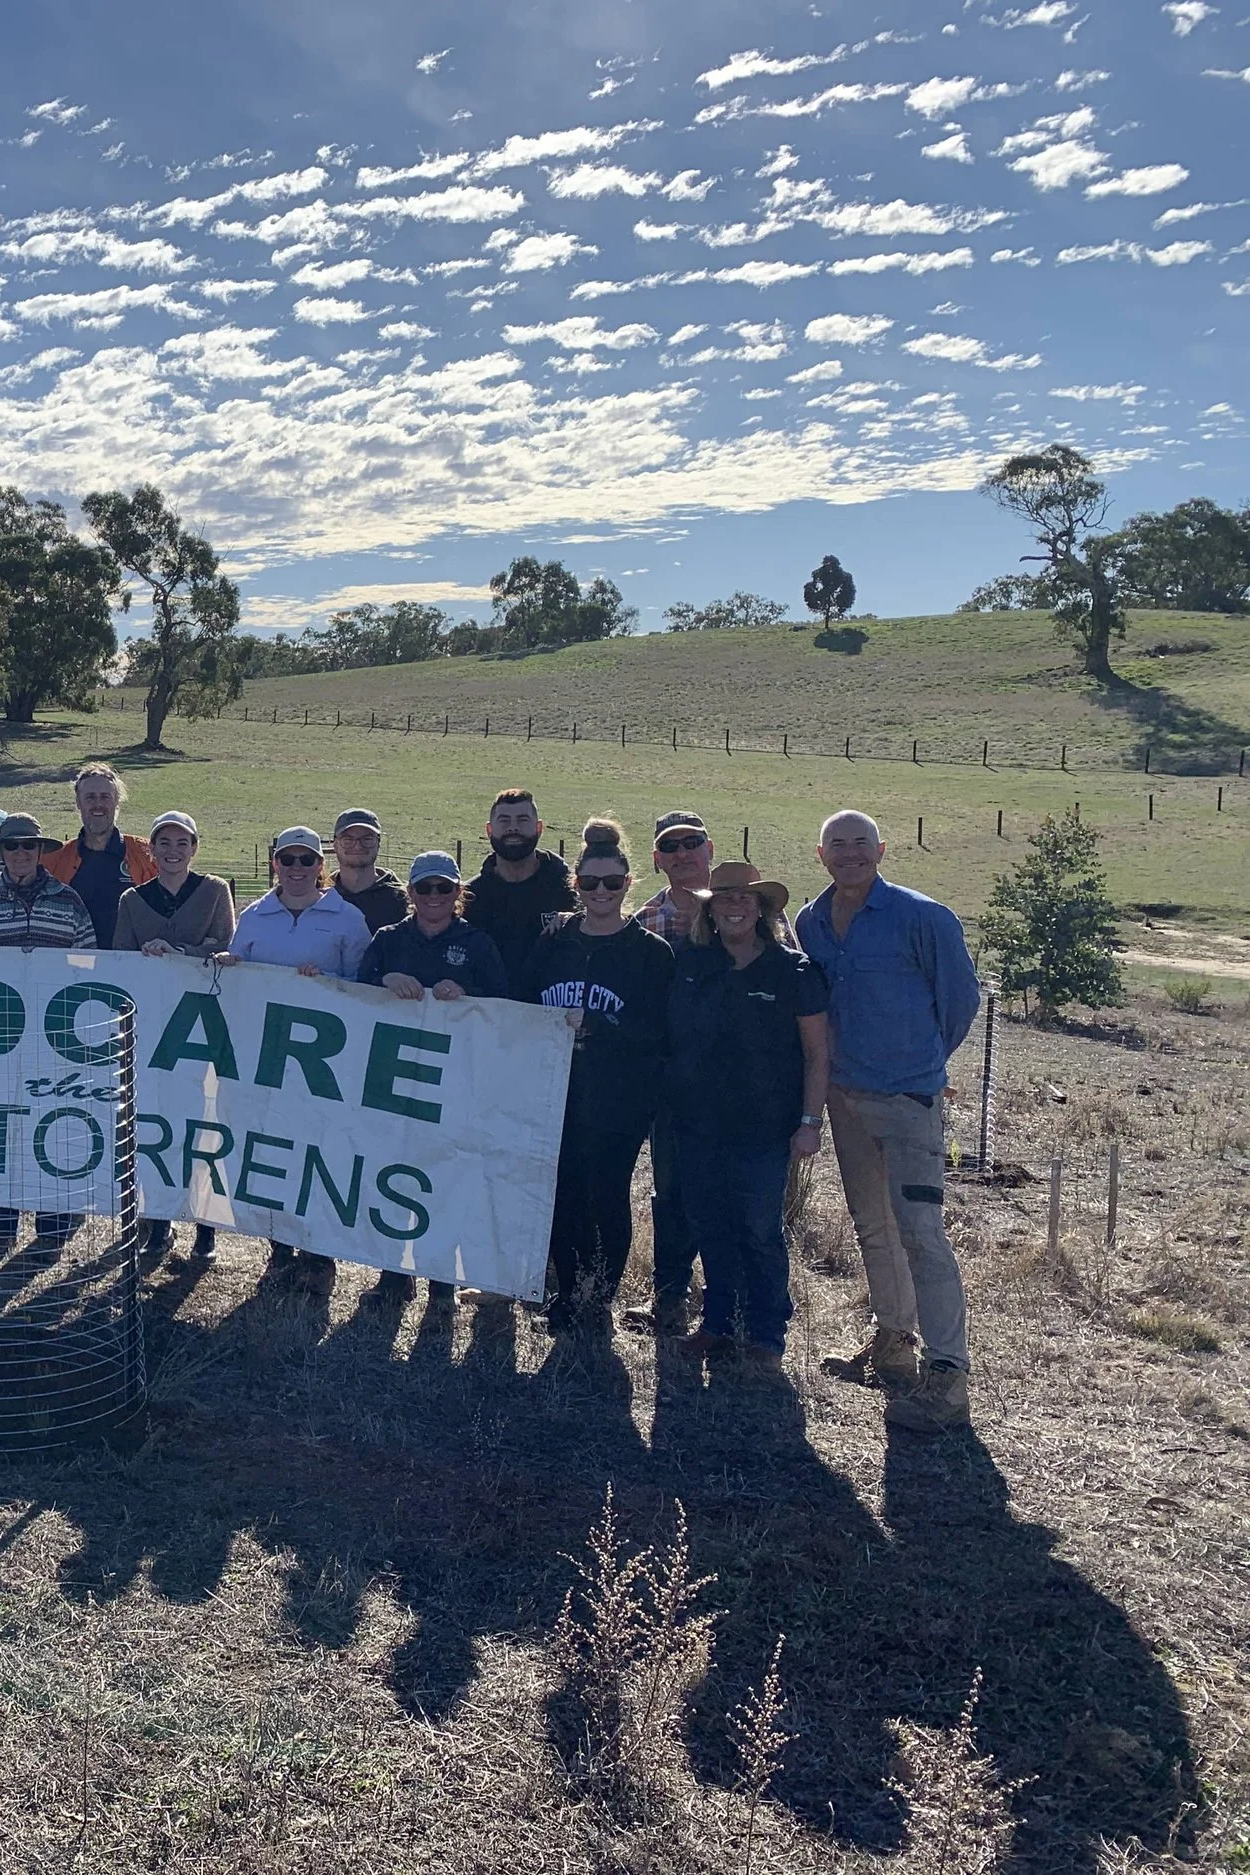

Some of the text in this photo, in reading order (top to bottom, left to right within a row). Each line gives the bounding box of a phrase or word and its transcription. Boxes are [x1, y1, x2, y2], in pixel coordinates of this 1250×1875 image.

[541, 981, 624, 1012] DODGE CITY
[24, 1073, 121, 1101] the
